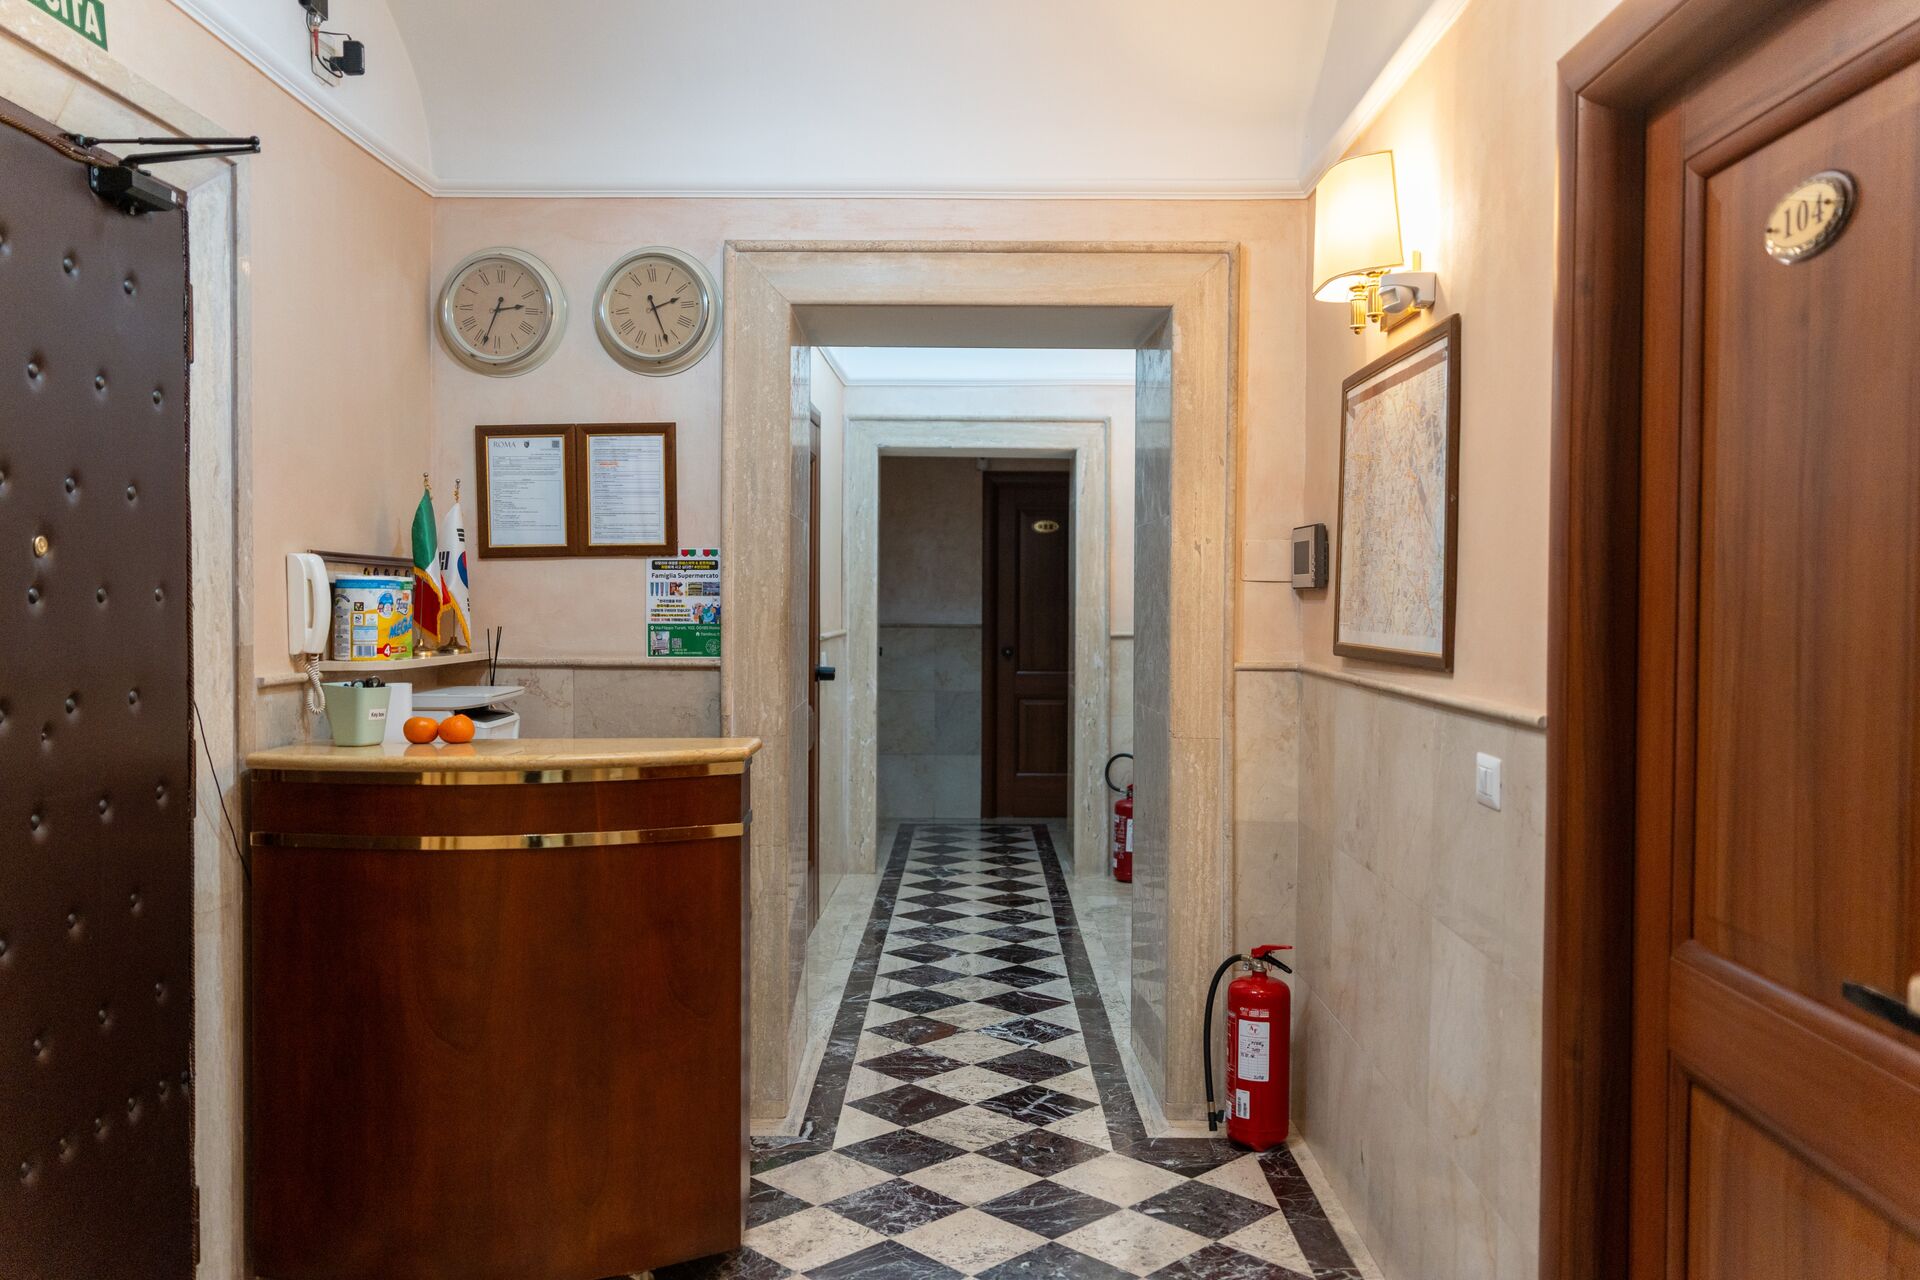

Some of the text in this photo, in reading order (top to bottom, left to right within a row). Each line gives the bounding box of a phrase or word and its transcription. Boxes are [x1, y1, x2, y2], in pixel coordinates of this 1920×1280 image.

[1784, 192, 1825, 238] 104
[494, 440, 516, 448] ROMA
[384, 645, 390, 656] 4
